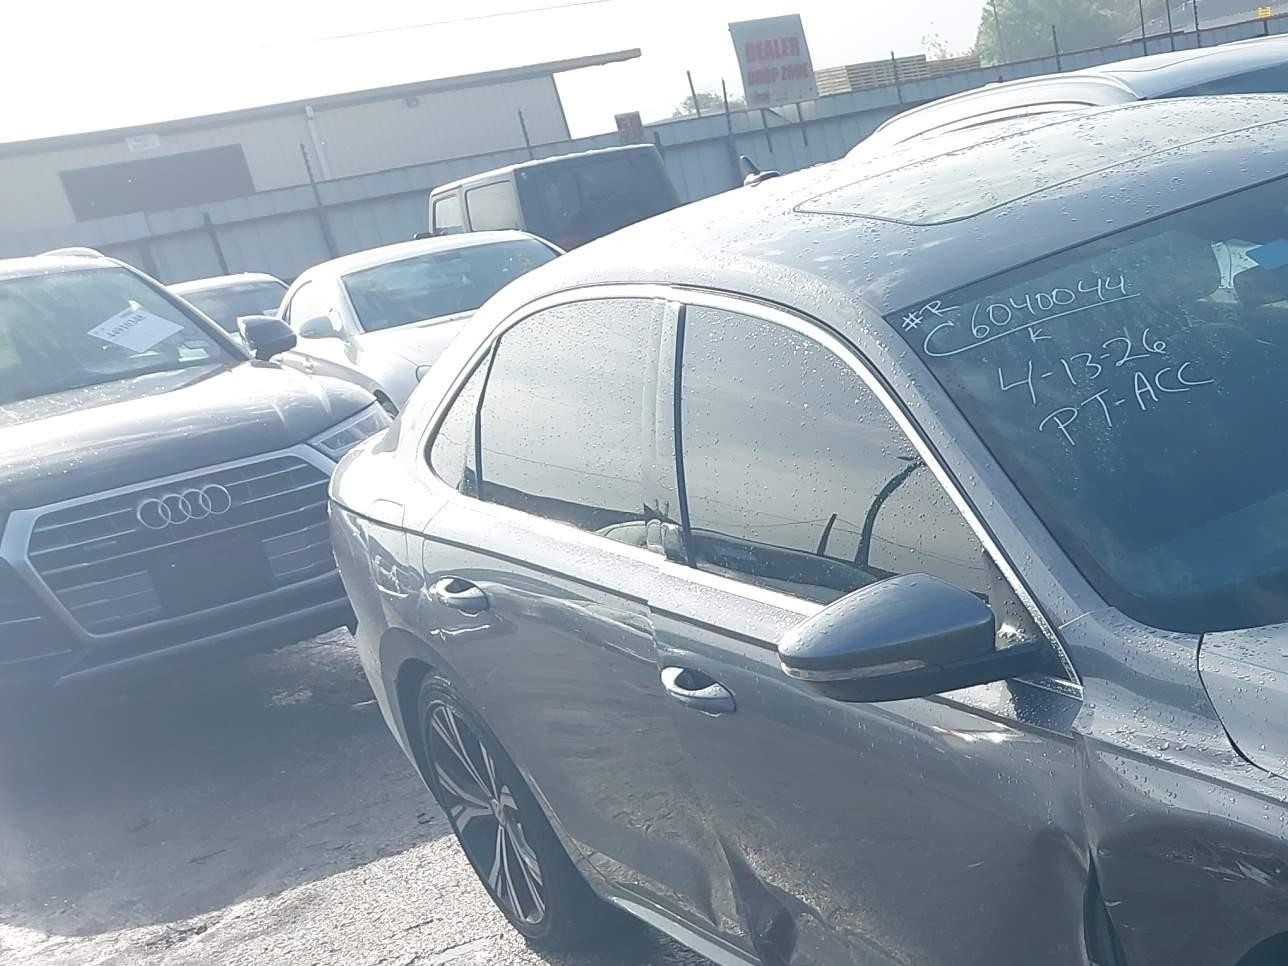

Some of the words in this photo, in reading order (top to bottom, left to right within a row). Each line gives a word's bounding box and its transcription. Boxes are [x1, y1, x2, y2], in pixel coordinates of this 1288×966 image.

[744, 37, 801, 62] DEALER
[998, 327, 1167, 405] 4-13-26
[1039, 362, 1214, 446] PT-ACC
